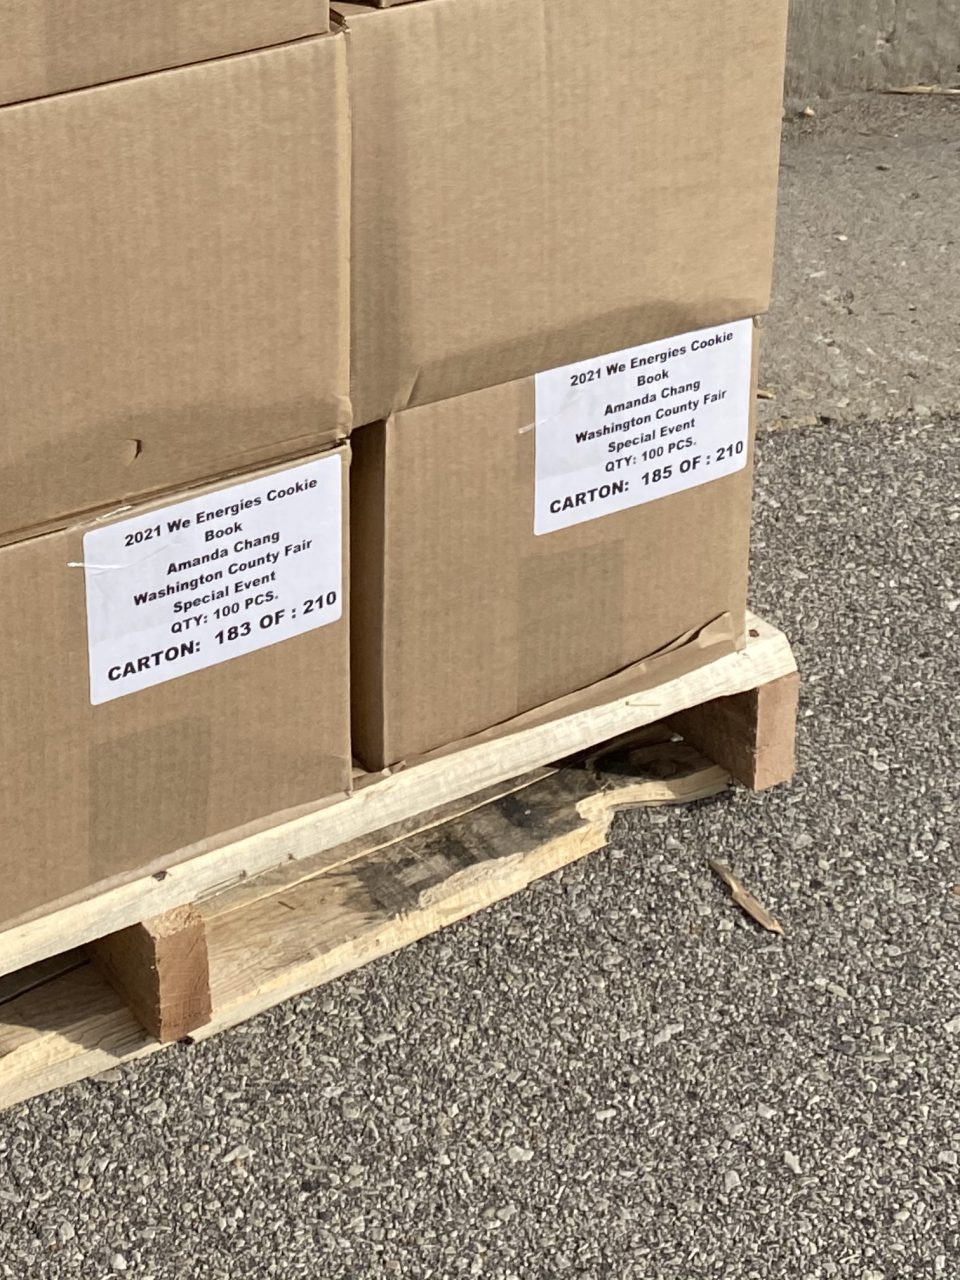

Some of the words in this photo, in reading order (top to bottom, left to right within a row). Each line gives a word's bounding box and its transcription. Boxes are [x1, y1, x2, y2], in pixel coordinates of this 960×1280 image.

[570, 367, 601, 387] 2021
[605, 362, 626, 376] We
[630, 346, 687, 370] Energies
[690, 332, 733, 352] Cookie
[637, 368, 669, 387] Book
[575, 414, 652, 444] Washington
[655, 399, 700, 420] County
[703, 390, 727, 405] Fair
[604, 393, 657, 417] Amanda
[660, 380, 701, 399] Chang
[604, 455, 637, 473] QTY:
[641, 446, 664, 462] 100
[667, 436, 697, 454] PCS.
[607, 429, 656, 454] Special
[660, 417, 696, 438] Event
[549, 479, 630, 514] CARTON:
[641, 464, 673, 486] 185
[715, 440, 744, 462] 210
[124, 524, 161, 548] 2021
[166, 518, 191, 533] We
[196, 496, 262, 525] Energies
[266, 478, 318, 502] Cookie
[204, 521, 243, 543] Book
[133, 570, 223, 607] Washington
[227, 551, 280, 575] County
[284, 539, 313, 557] Fair
[166, 547, 229, 576] Amanda
[233, 531, 280, 553] Chang
[170, 613, 208, 634] QTY:
[213, 602, 240, 620] 100
[244, 590, 279, 610] PCS.
[173, 585, 230, 614] Special
[234, 570, 276, 594] Event
[107, 639, 201, 682] CARTON:
[214, 621, 252, 645] 183
[302, 590, 337, 615] 210
